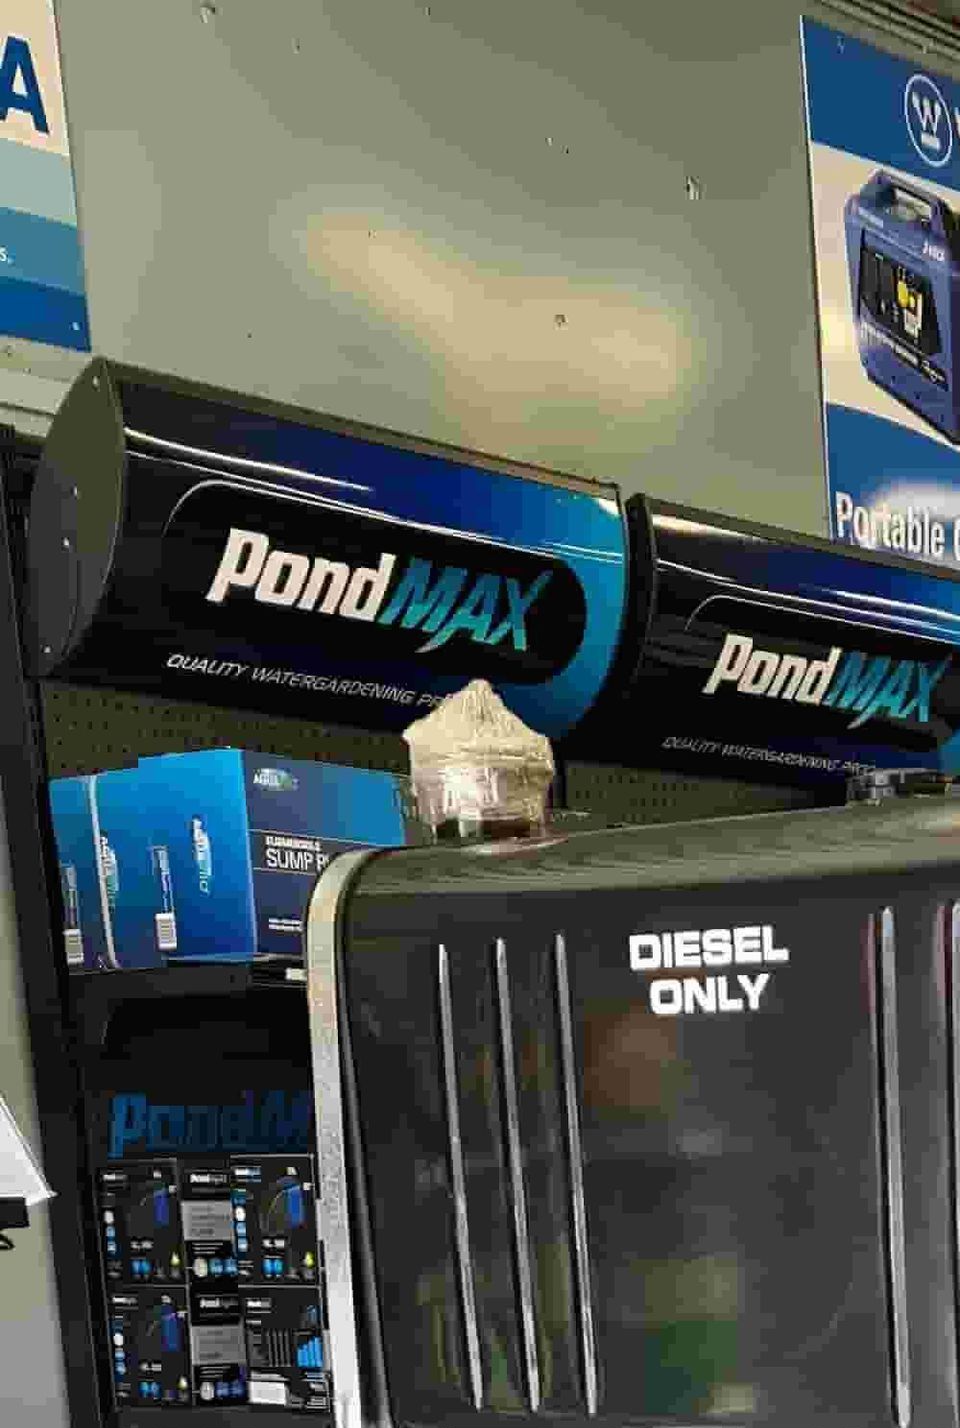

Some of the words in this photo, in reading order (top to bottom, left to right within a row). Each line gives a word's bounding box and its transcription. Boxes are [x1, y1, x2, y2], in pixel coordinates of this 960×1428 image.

[834, 491, 945, 558] Portable
[206, 527, 553, 653] PondMAX
[166, 653, 250, 679] QUALITY
[250, 665, 415, 706] WATERGARDENING
[702, 632, 952, 730] PondMAX
[266, 847, 313, 870] SUMP
[629, 926, 790, 971] DIESEL
[651, 973, 770, 1015] ONLY
